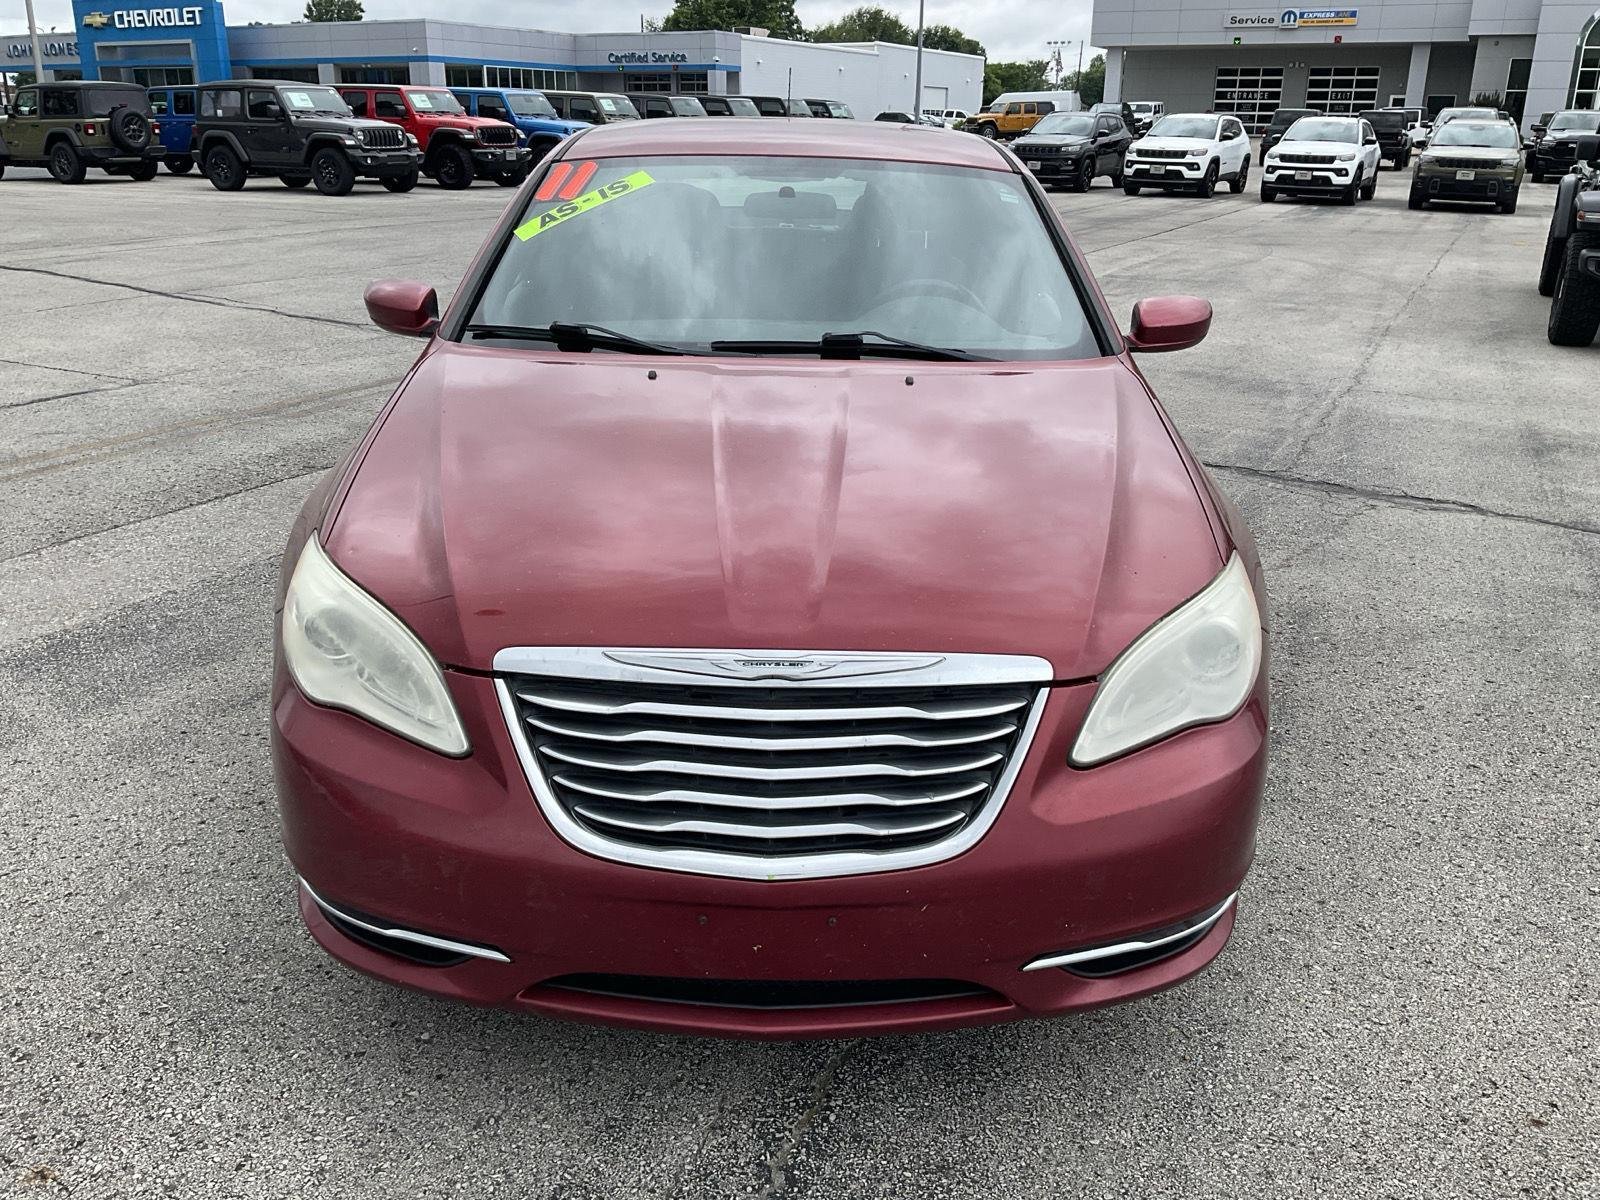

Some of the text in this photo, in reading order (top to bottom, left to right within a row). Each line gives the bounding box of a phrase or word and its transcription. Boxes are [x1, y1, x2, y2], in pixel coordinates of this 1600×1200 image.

[113, 7, 203, 29] CHEVROLET
[1230, 15, 1275, 25] Service
[608, 51, 687, 64] Certified Service
[1227, 92, 1269, 100] ENTRANCE
[1331, 92, 1351, 100] EXIT
[534, 159, 600, 202] 11
